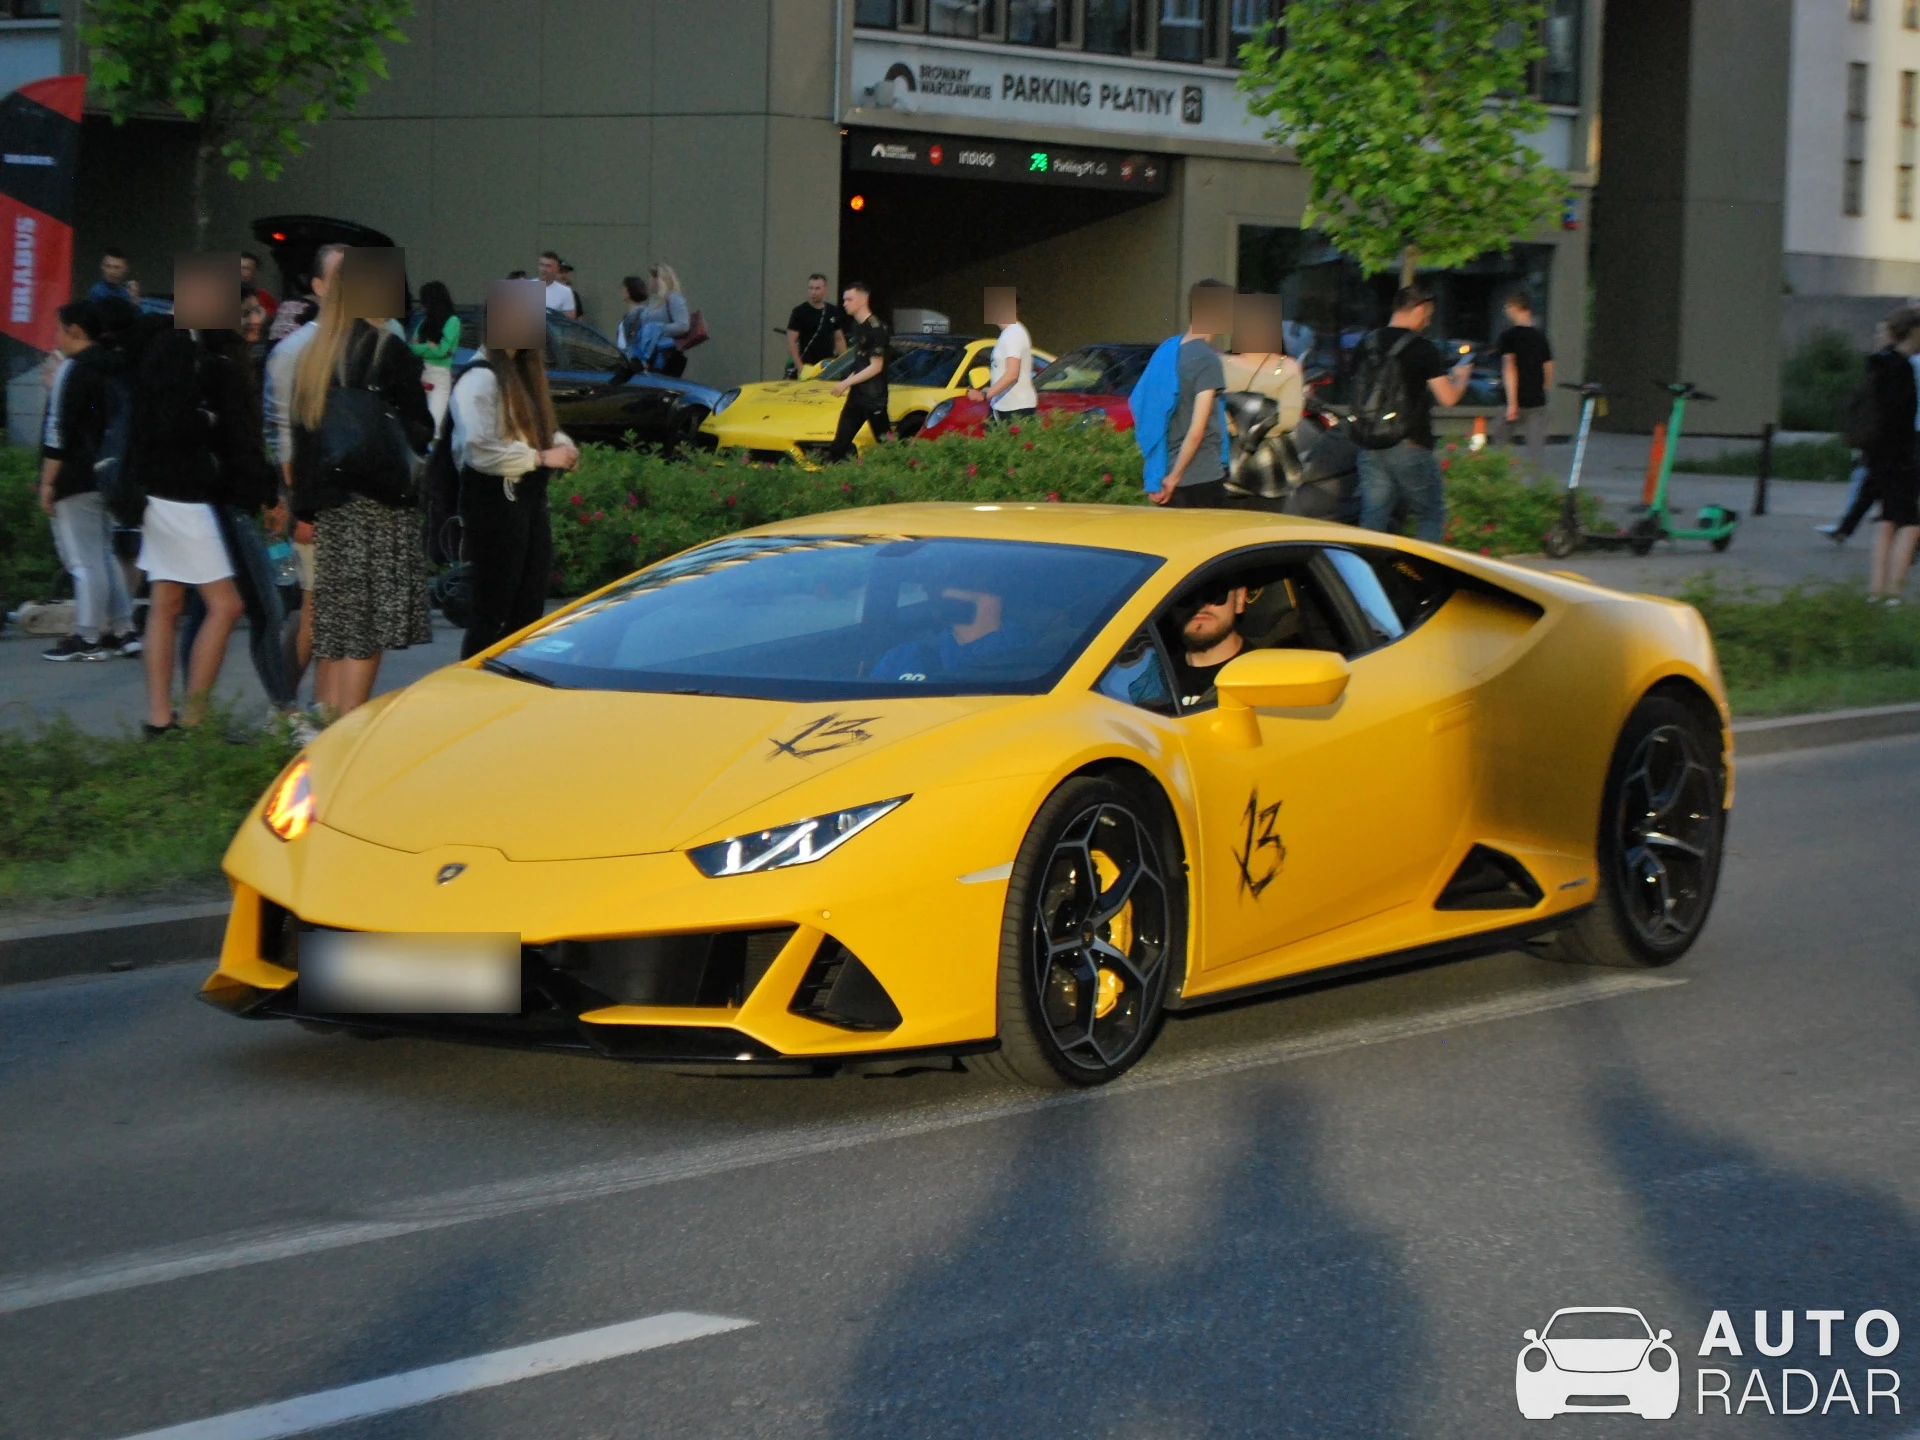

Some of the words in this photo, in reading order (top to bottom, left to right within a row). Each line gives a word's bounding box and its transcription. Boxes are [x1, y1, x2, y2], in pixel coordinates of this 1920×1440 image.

[1002, 73, 1092, 108] PARKING
[1100, 83, 1176, 116] PŁATNY
[11, 215, 36, 323] BRABUS
